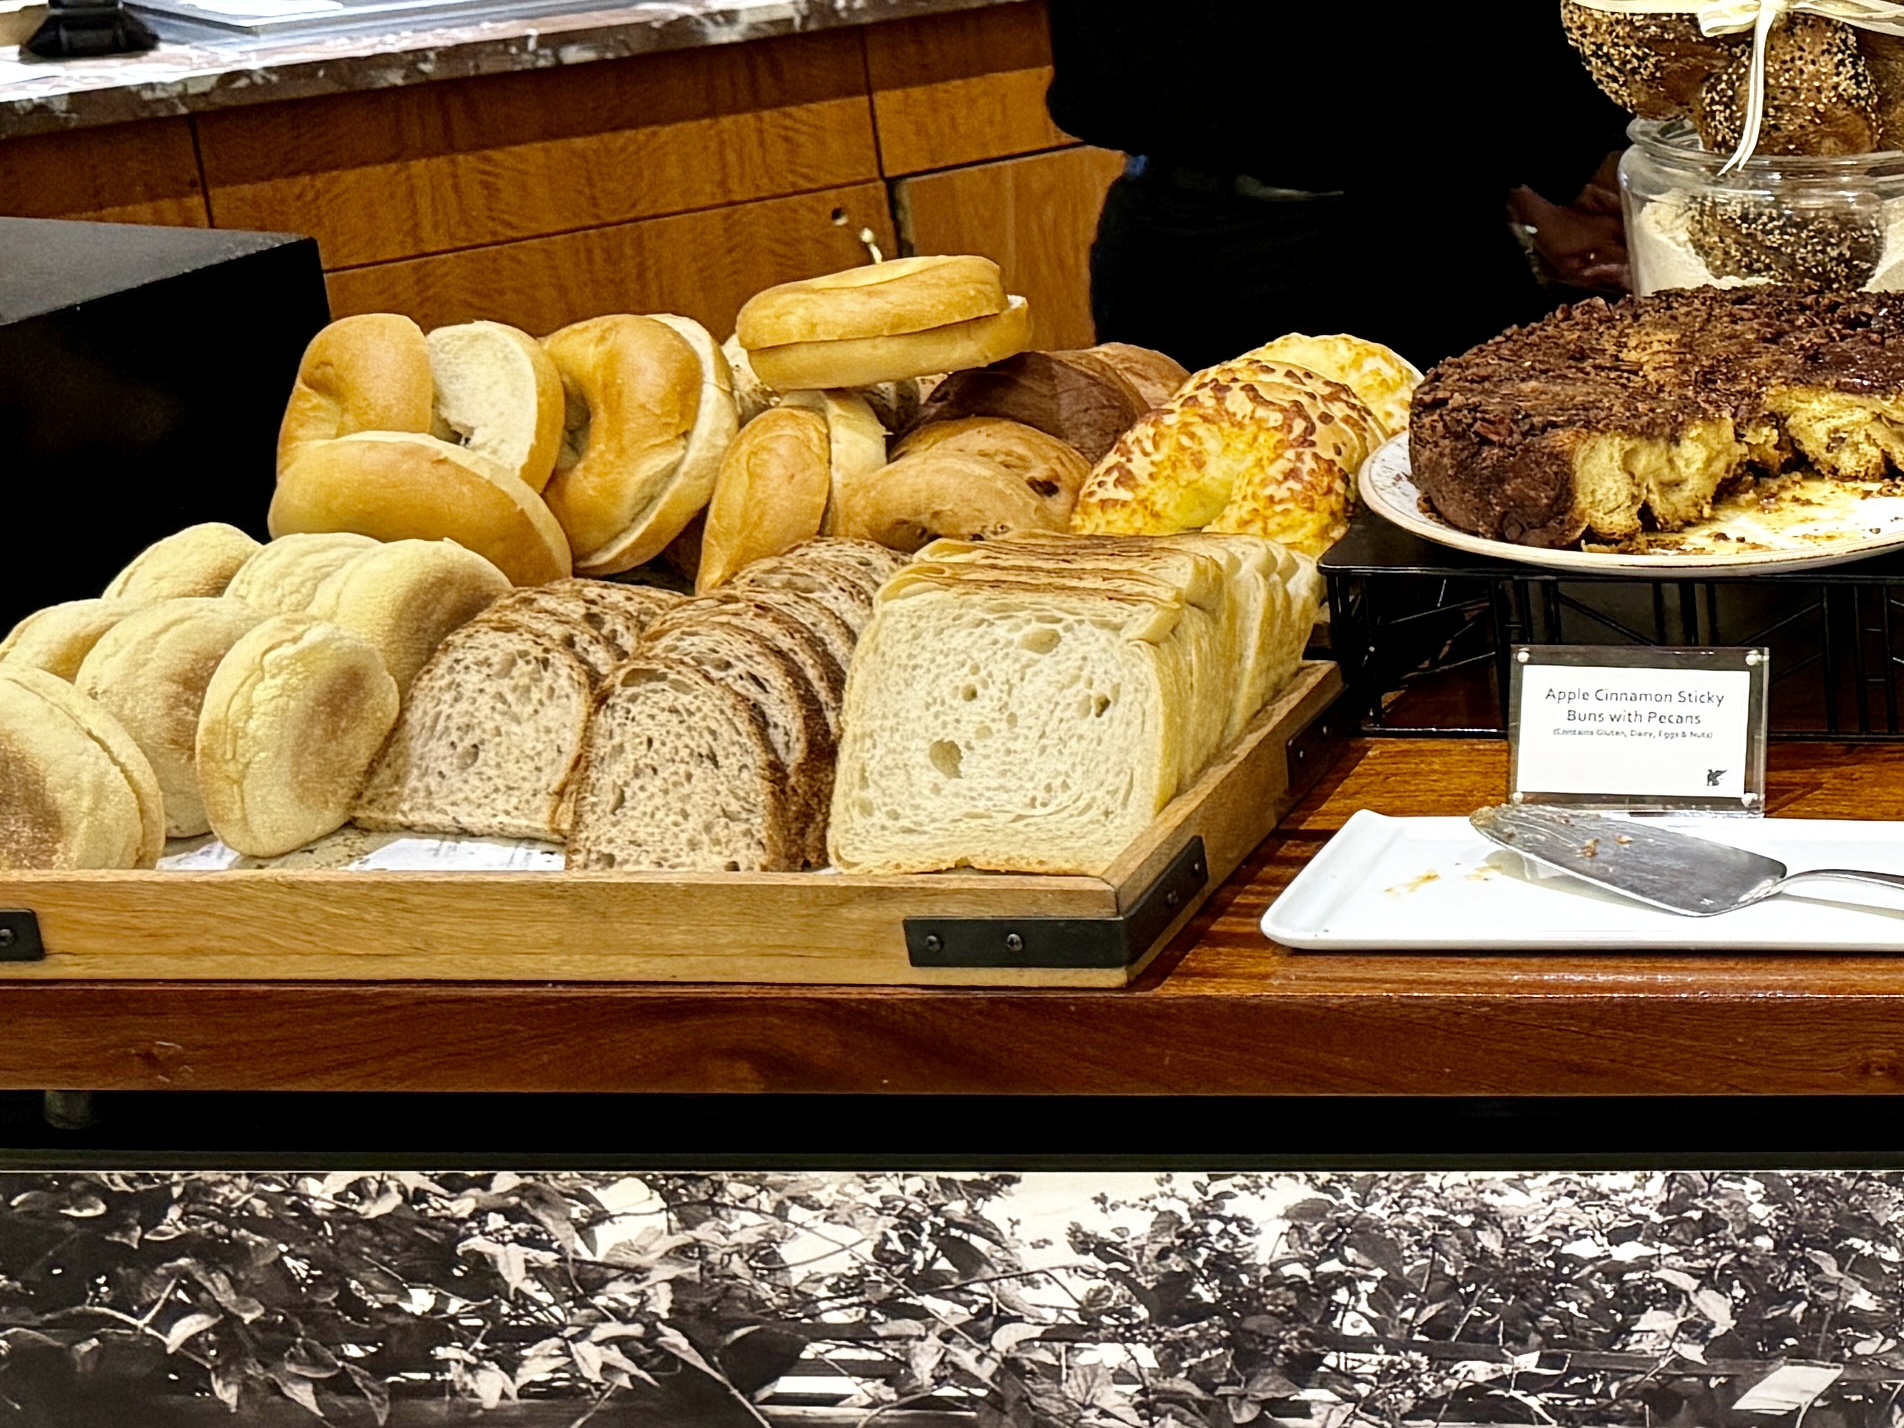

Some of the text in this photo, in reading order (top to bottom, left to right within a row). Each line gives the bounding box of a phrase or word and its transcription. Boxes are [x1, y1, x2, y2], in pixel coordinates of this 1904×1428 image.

[1546, 687, 1725, 707] Apple Cinnamon Sticky
[1567, 709, 1702, 725] Buns with Pecans
[1553, 727, 1594, 737] (Contains
[1596, 728, 1627, 738] Gluten,
[1630, 729, 1656, 739] Dairy,
[1658, 730, 1679, 740] Eggs
